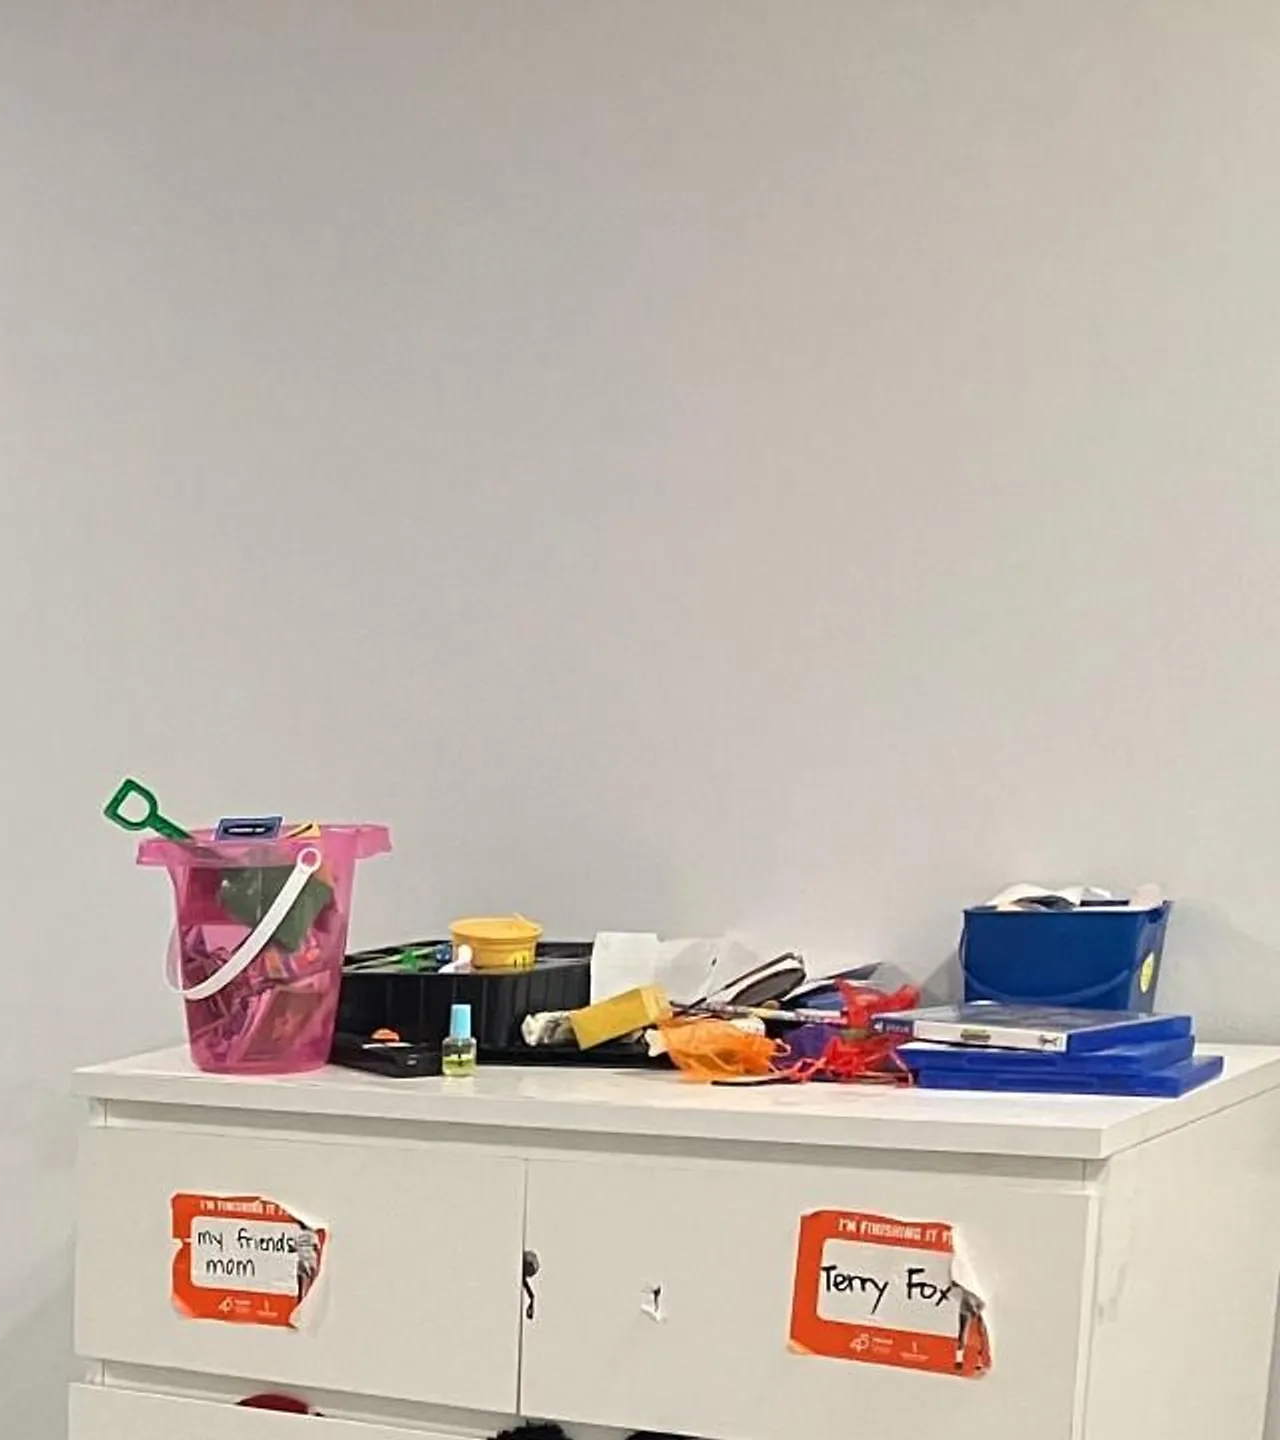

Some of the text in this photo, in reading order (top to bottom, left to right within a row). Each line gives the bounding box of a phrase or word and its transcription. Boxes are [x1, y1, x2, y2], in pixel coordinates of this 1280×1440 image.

[198, 1227, 298, 1253] my friends
[205, 1257, 255, 1277] mom
[820, 1264, 952, 1315] Terry Fox
